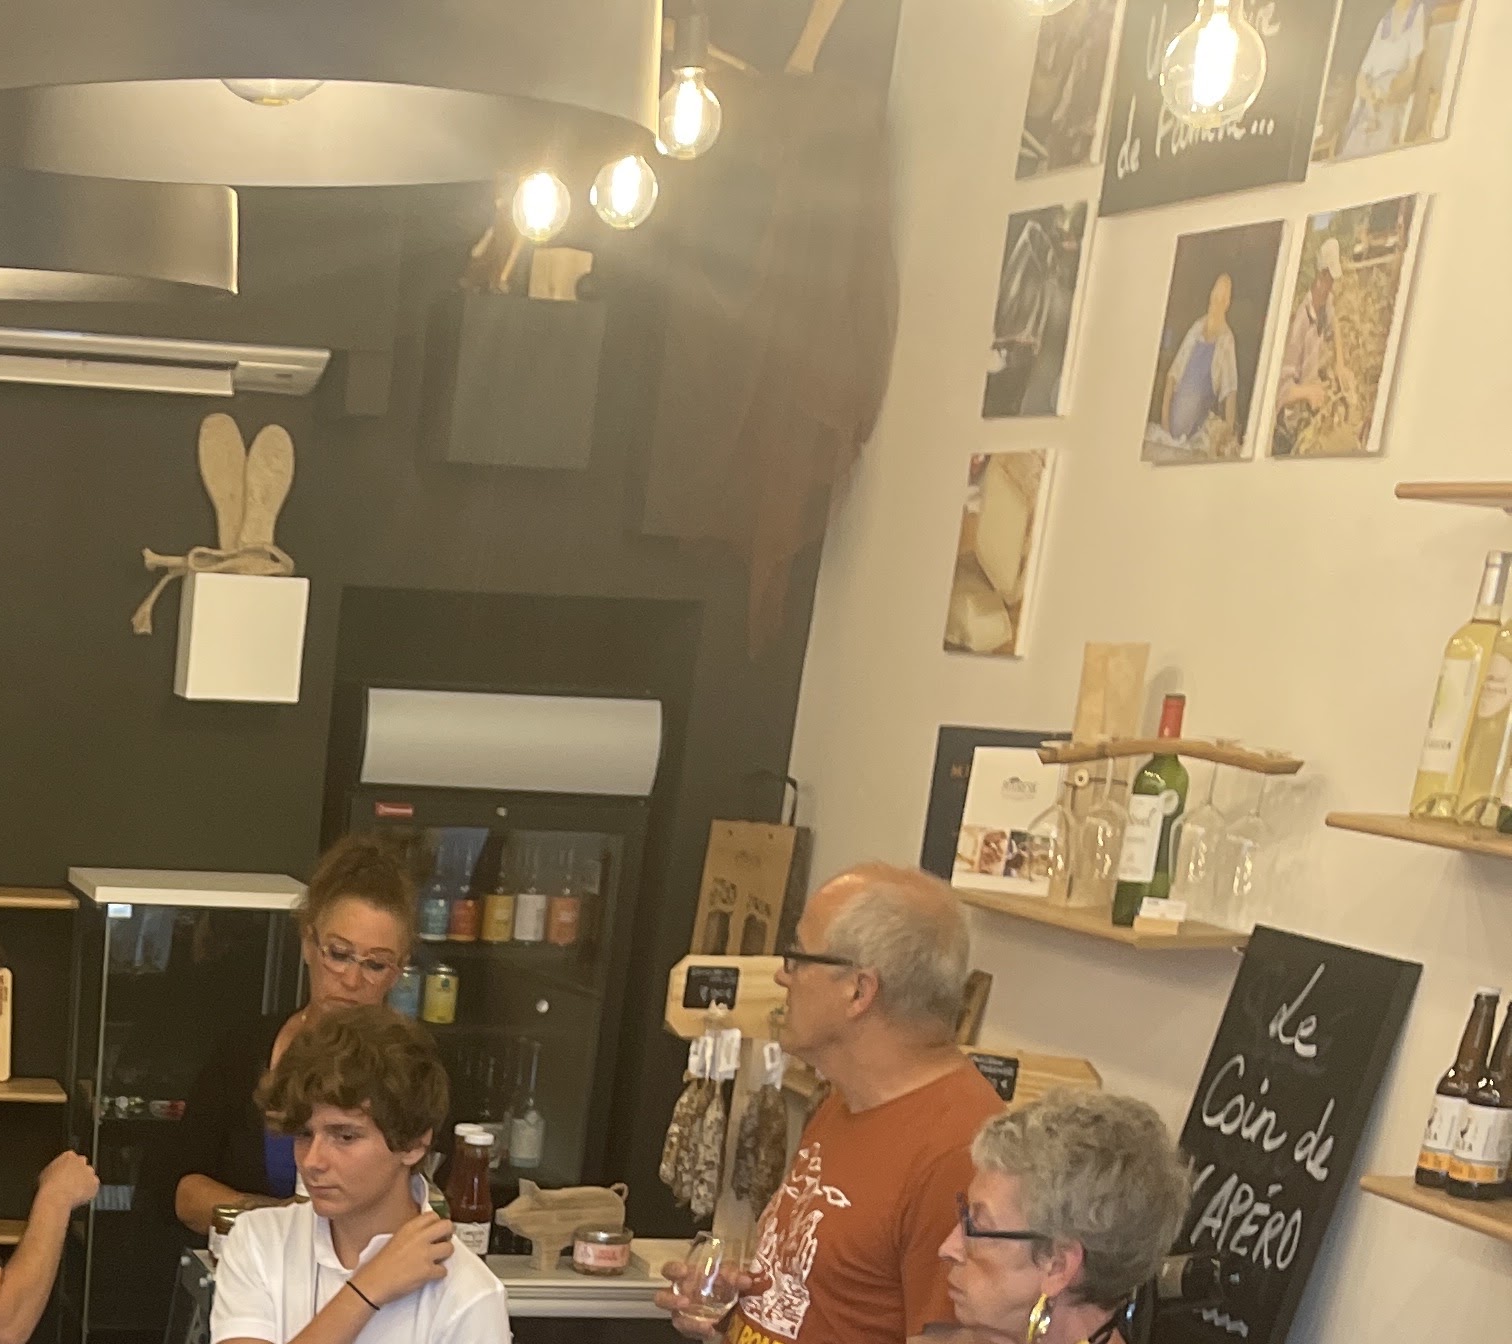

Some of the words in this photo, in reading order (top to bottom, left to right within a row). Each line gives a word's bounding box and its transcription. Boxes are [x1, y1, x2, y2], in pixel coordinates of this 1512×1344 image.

[1269, 963, 1326, 1058] Le
[1202, 1054, 1287, 1152] Coin
[1294, 1098, 1335, 1182] de
